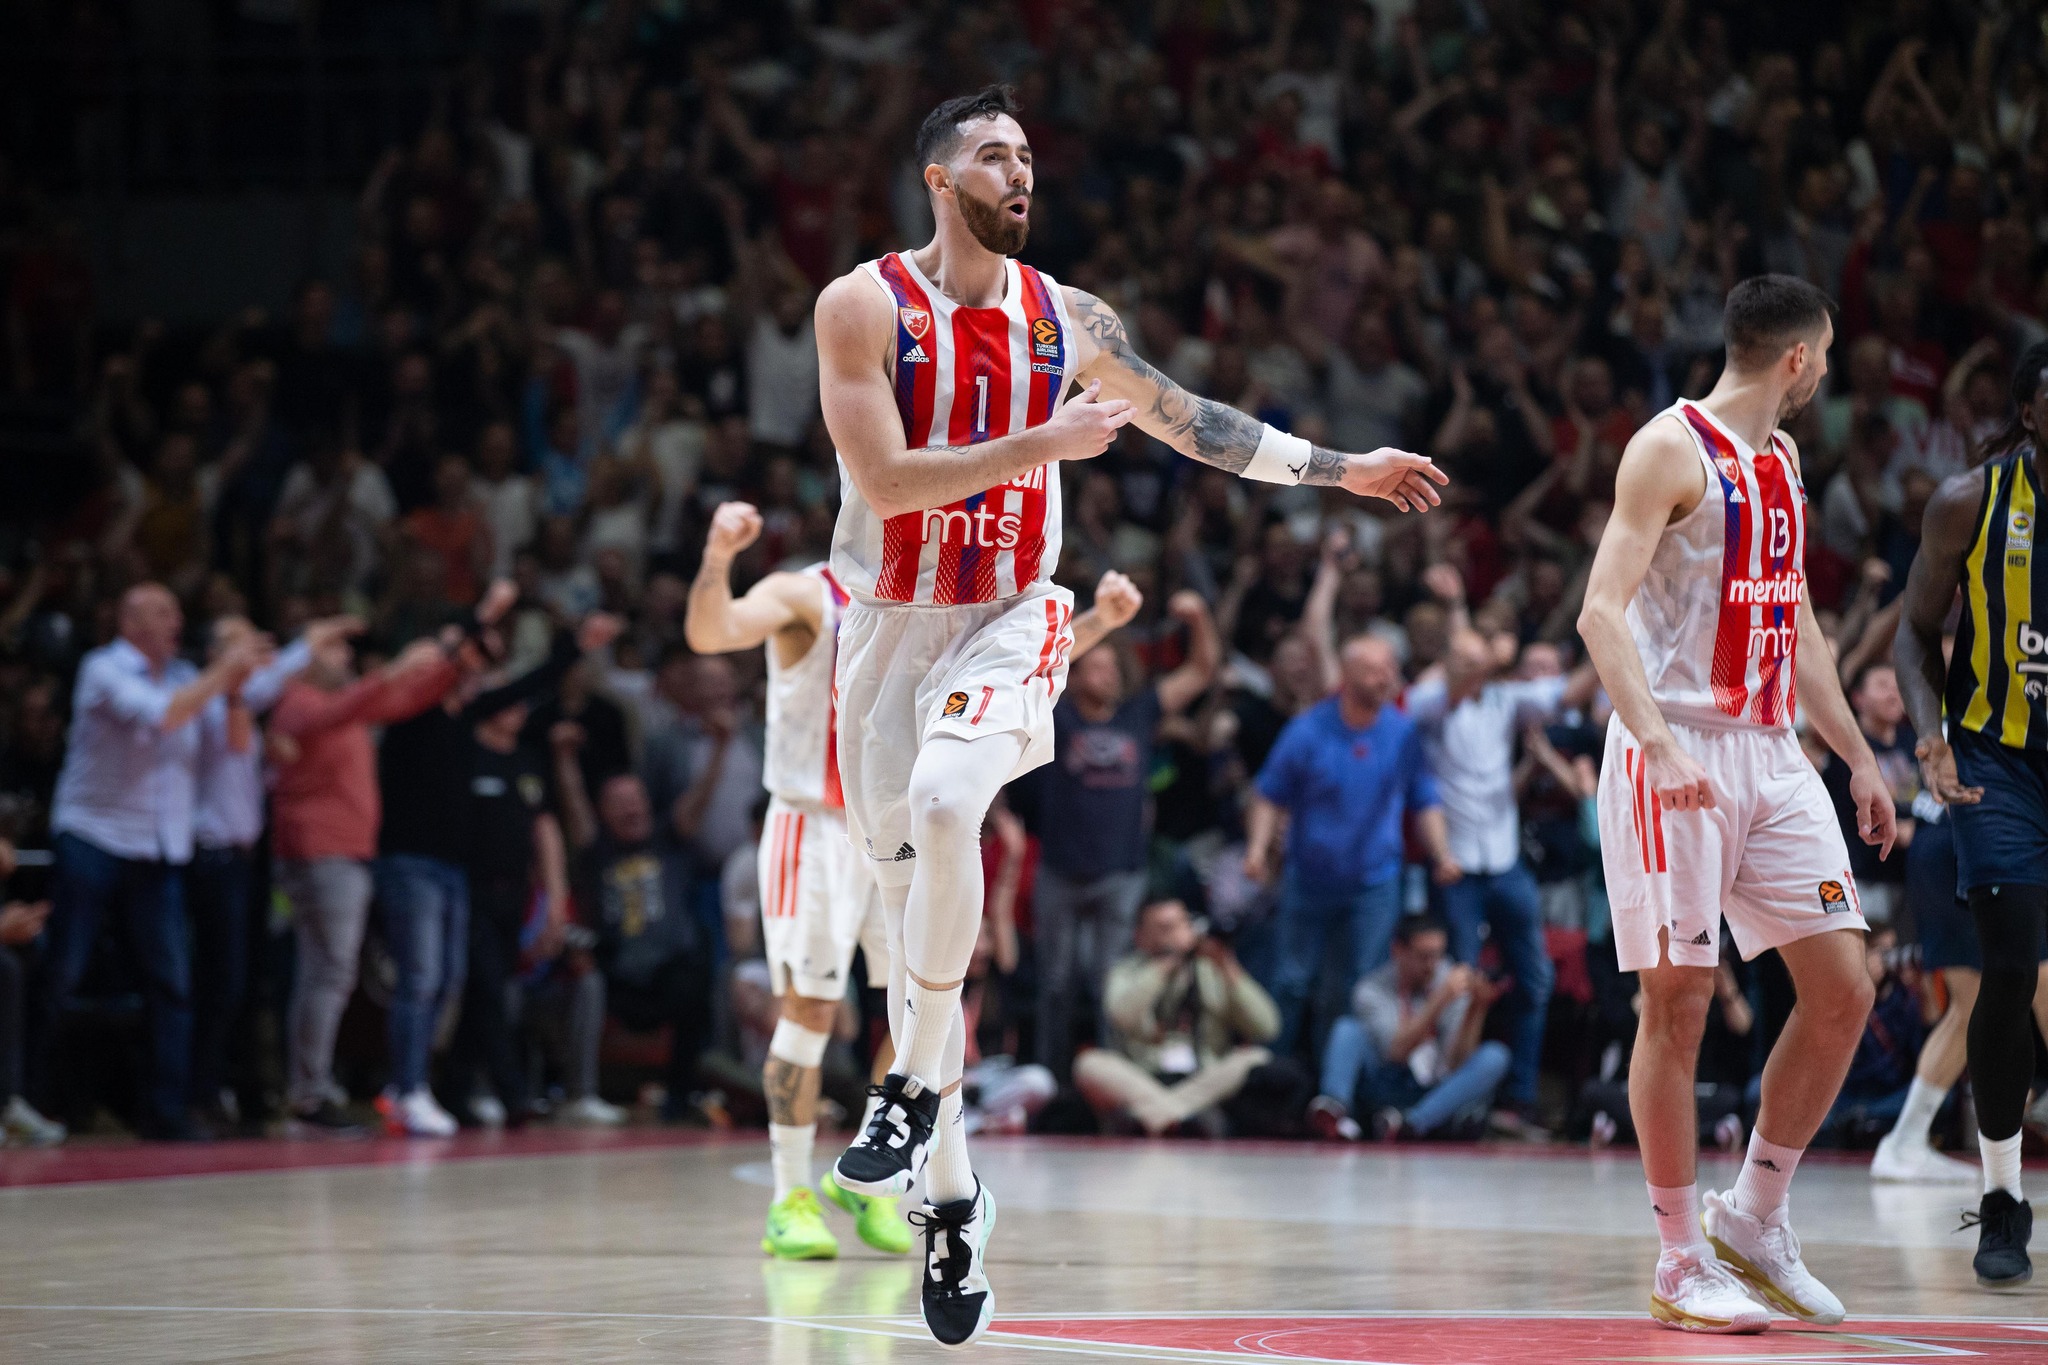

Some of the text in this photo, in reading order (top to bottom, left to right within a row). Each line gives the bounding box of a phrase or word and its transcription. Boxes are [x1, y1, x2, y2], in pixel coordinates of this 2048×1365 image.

[902, 354, 930, 363] adidas
[1032, 363, 1063, 376] oneteam
[976, 375, 988, 433] 1
[921, 504, 1022, 549] mts
[1768, 507, 1790, 558] 13
[1747, 620, 1795, 658] mt
[970, 685, 995, 727] 1
